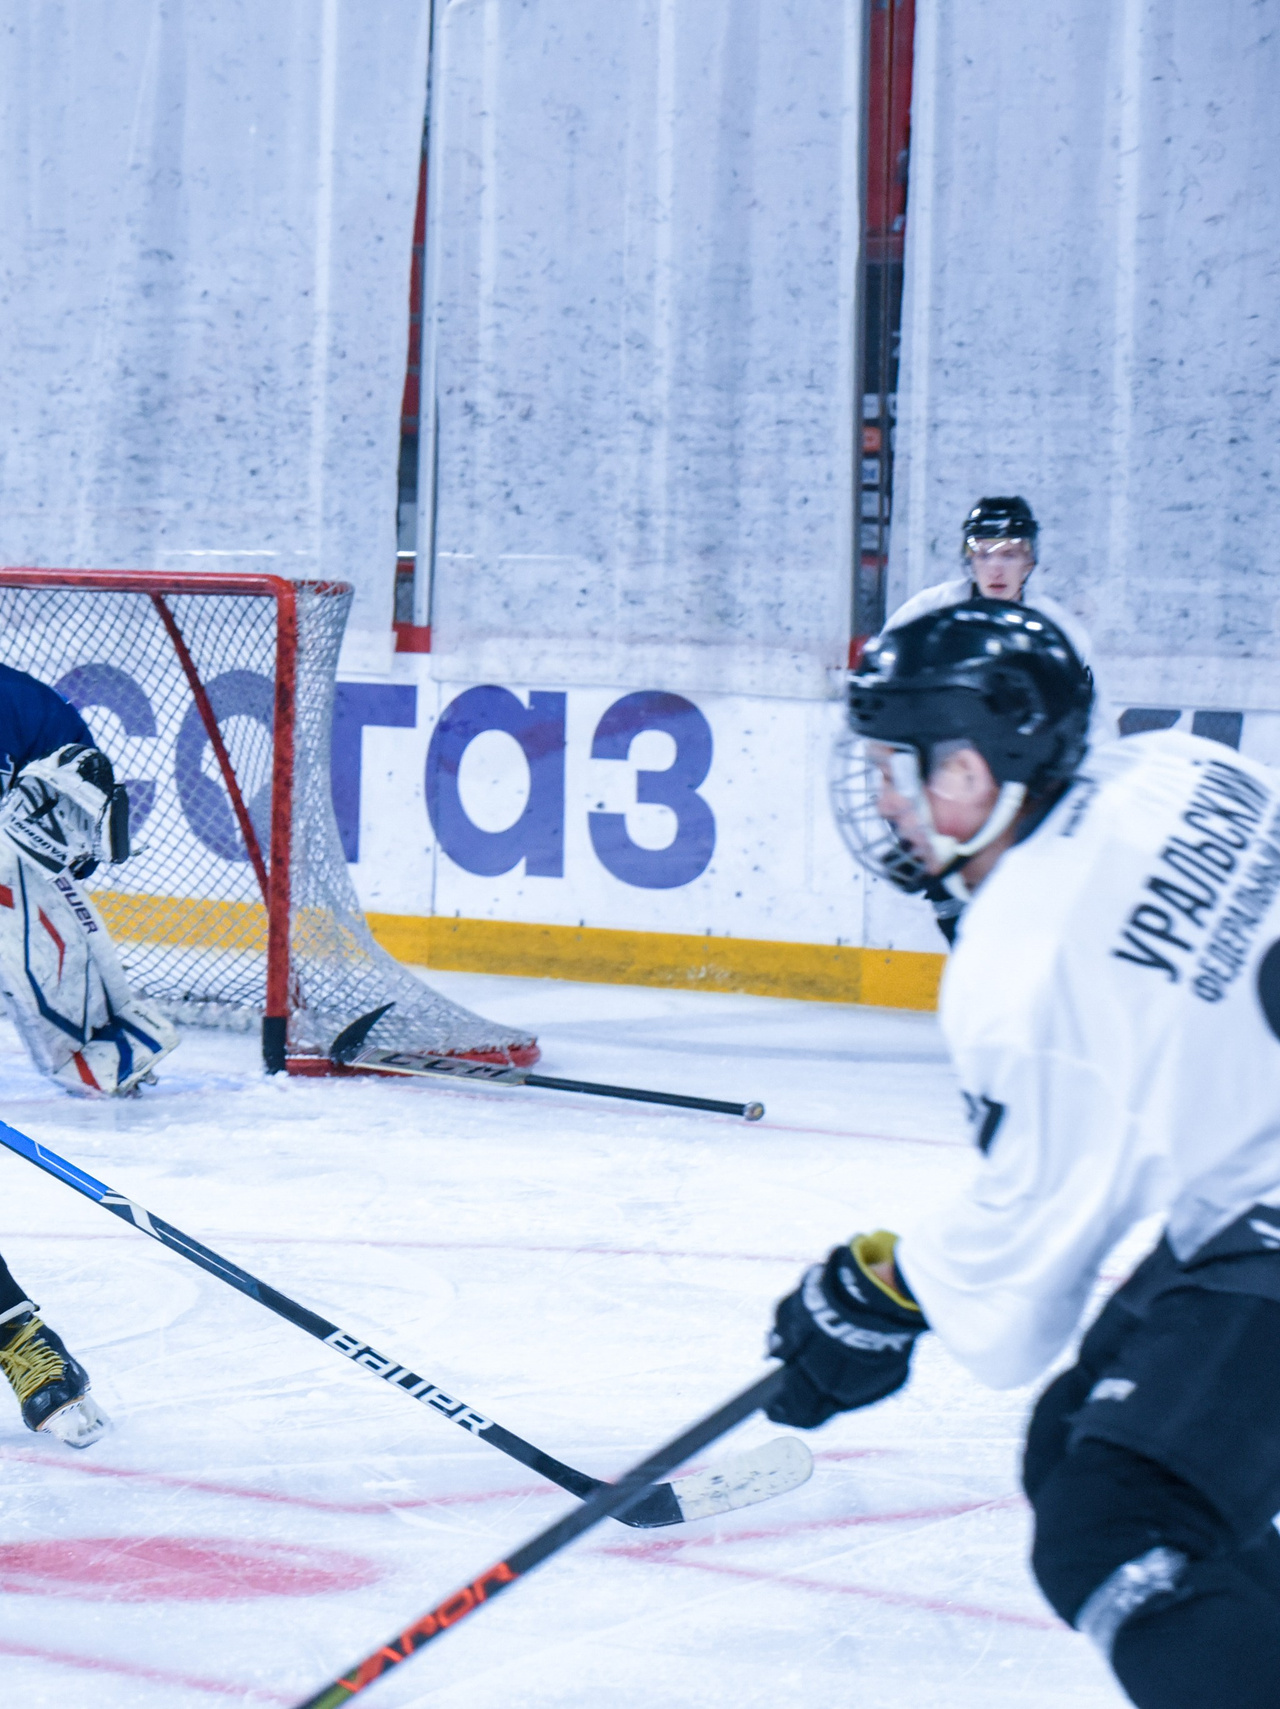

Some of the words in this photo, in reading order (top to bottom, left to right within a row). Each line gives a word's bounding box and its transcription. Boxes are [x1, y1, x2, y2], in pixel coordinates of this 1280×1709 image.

[53, 876, 99, 934] AUER
[1113, 758, 1272, 983] УРАЛЬСКИЙ
[379, 1053, 510, 1078] CCM
[323, 1329, 495, 1436] BAUER
[336, 1561, 519, 1694] VAPOR
